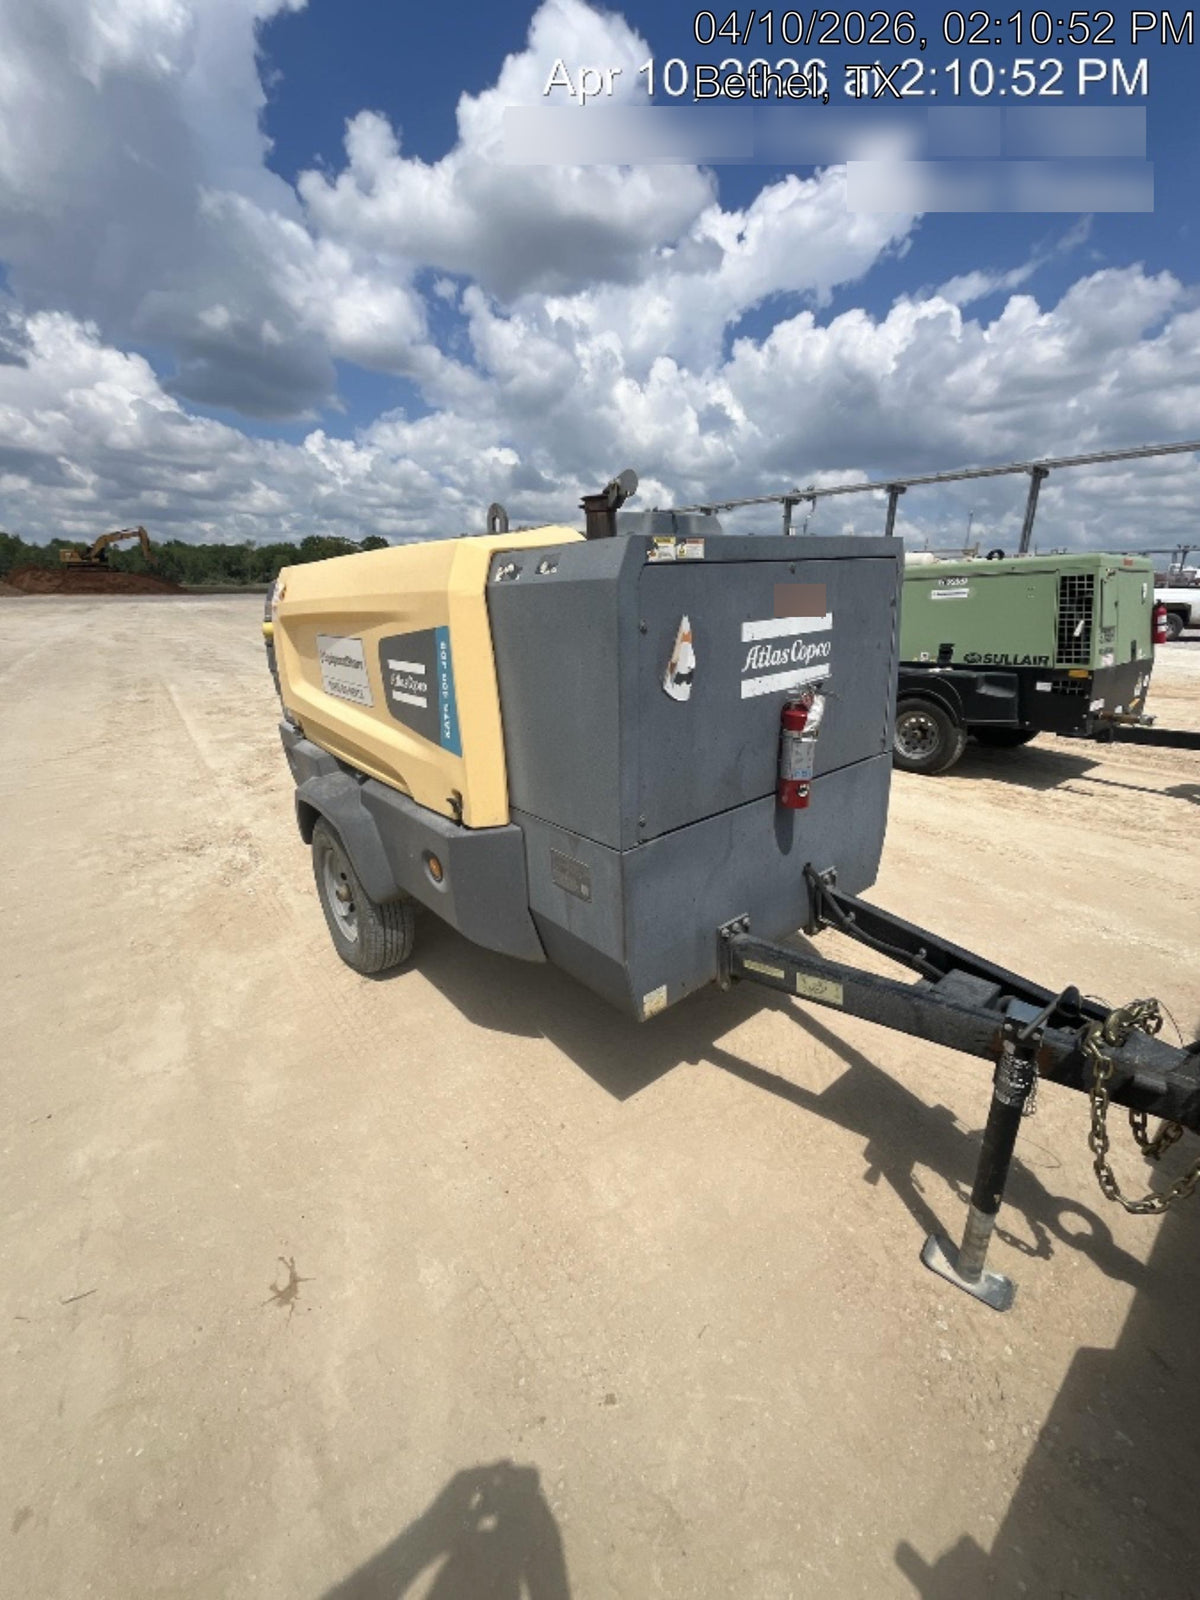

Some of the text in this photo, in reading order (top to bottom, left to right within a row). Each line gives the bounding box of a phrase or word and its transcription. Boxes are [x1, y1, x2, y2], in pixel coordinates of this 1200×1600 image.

[741, 639, 832, 673] Atlas Copco
[982, 653, 1050, 666] SULLAIR
